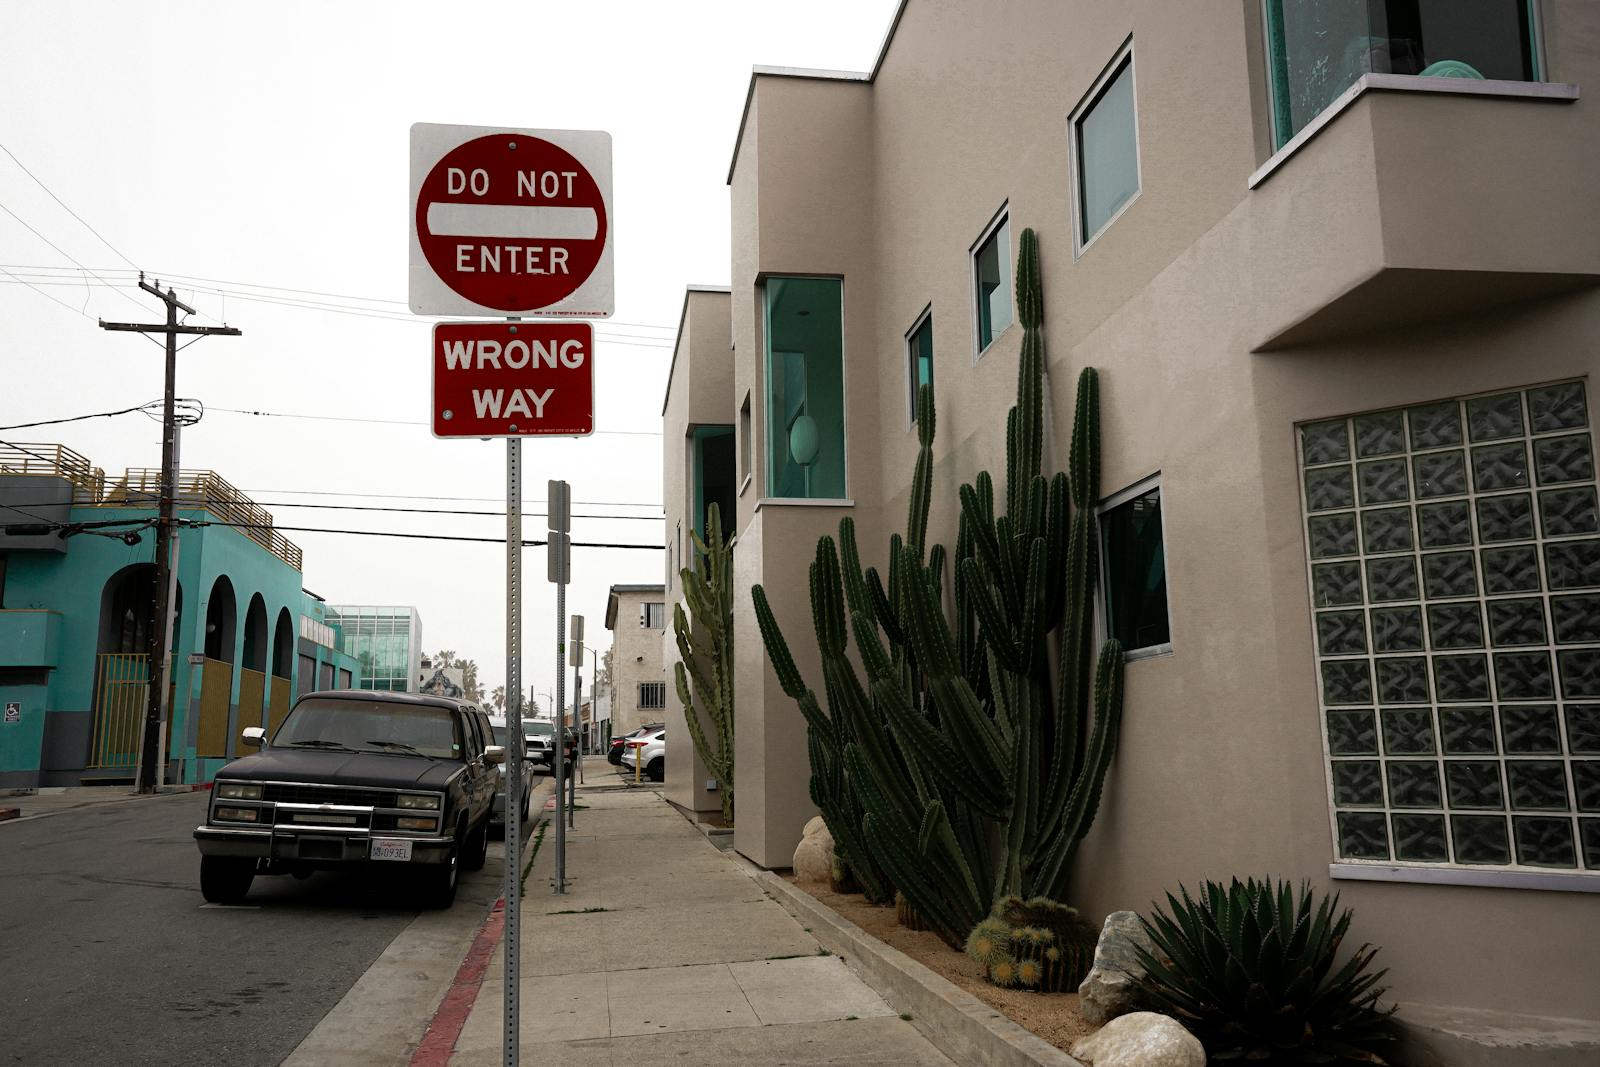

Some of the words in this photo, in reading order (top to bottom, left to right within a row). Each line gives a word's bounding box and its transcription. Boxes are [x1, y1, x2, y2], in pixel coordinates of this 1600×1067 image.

[447, 167, 490, 197] DO
[517, 170, 578, 199] NOT
[456, 244, 570, 275] ENTER
[442, 339, 585, 370] WRONG
[472, 388, 555, 419] WAY
